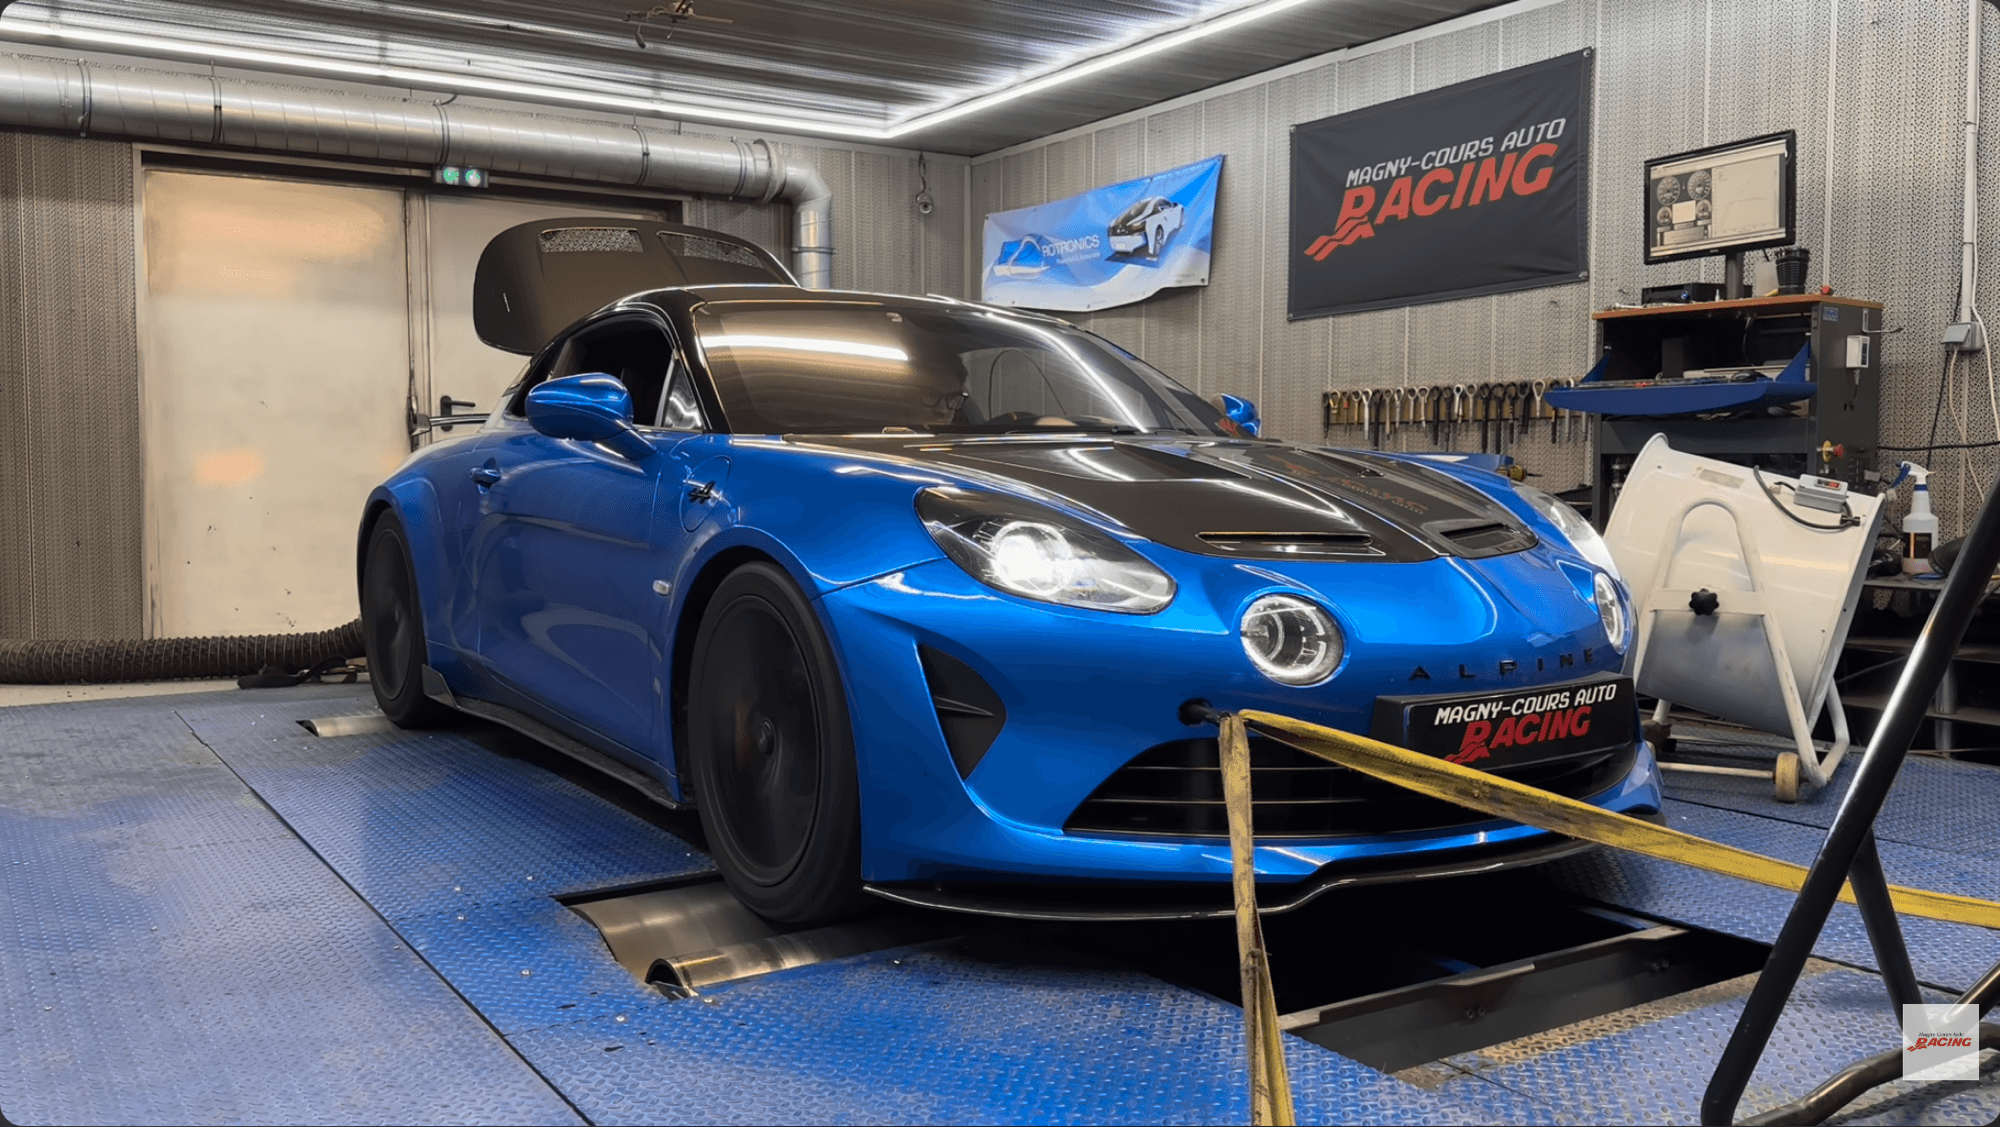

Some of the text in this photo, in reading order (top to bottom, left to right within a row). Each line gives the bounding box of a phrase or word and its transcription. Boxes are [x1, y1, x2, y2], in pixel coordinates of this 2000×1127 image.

[1346, 118, 1566, 188] MAGNY-COURS AUTO
[1304, 143, 1559, 261] RACING
[1409, 648, 1594, 681] ALPINE
[1434, 684, 1617, 725] MAGNY-COURS AUTO
[1443, 706, 1592, 765] RACING
